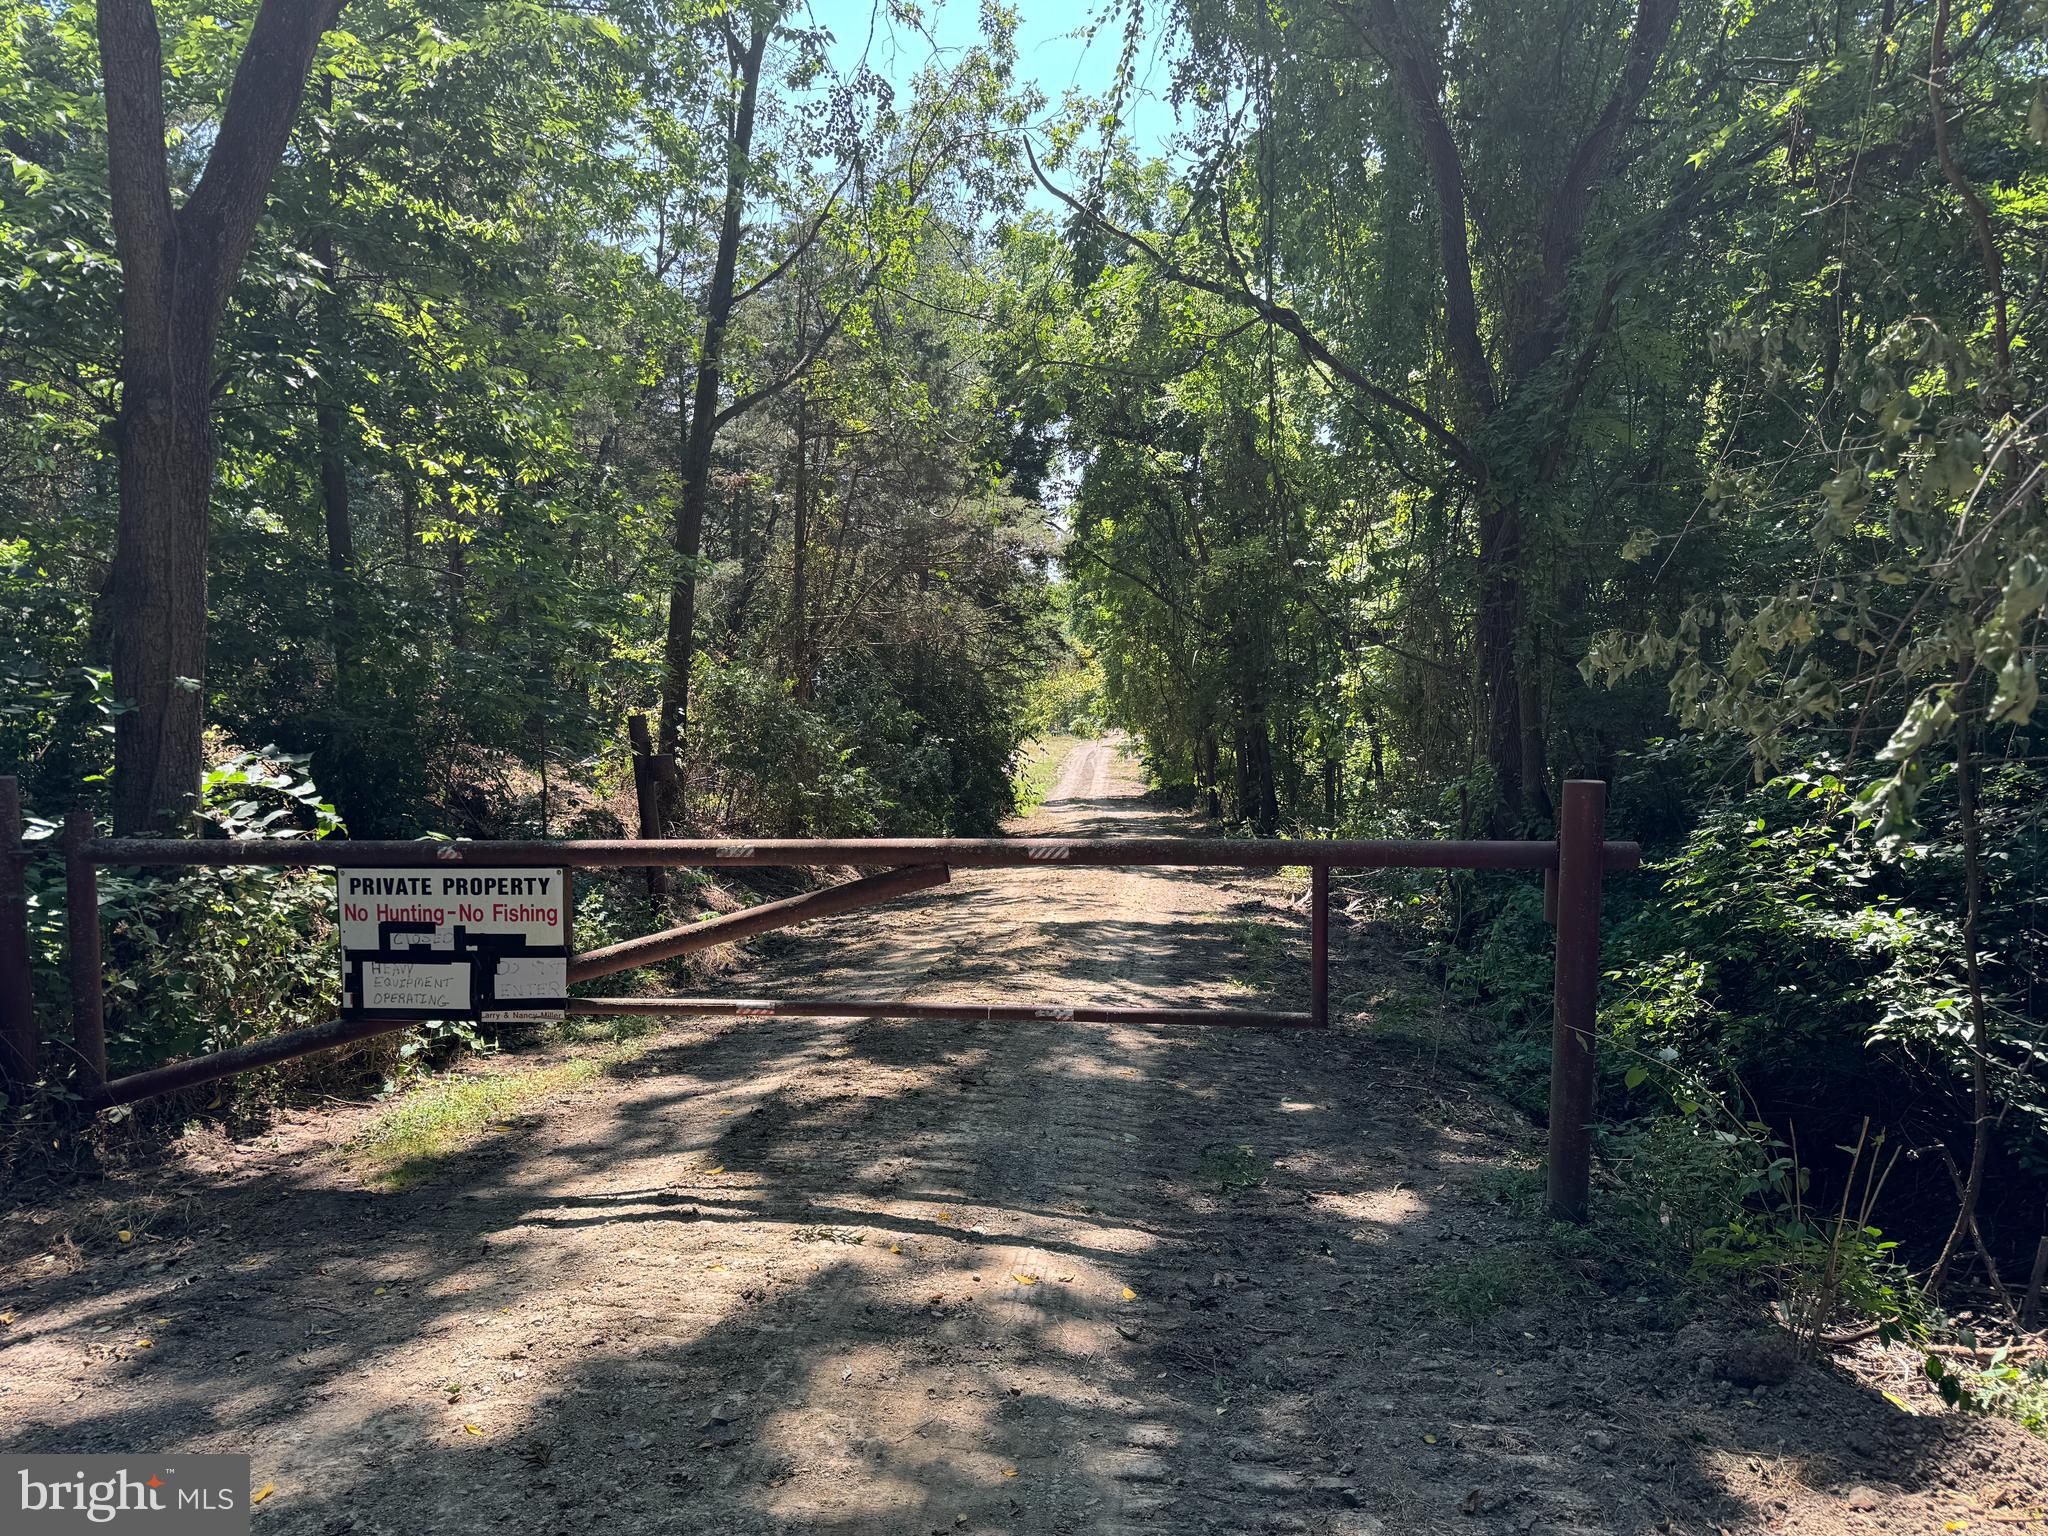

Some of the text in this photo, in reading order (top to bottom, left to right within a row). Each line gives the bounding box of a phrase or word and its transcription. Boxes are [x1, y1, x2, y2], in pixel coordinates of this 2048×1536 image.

[349, 877, 550, 896] PRIVATE PROPERTY
[344, 903, 369, 922] No
[492, 903, 558, 926] Fishing
[371, 962, 414, 978] HEAVY
[374, 976, 455, 989] EQUIPMENT
[501, 981, 560, 997] ENTER
[373, 993, 450, 1008] OPERATING
[512, 1011, 538, 1020] Nancy
